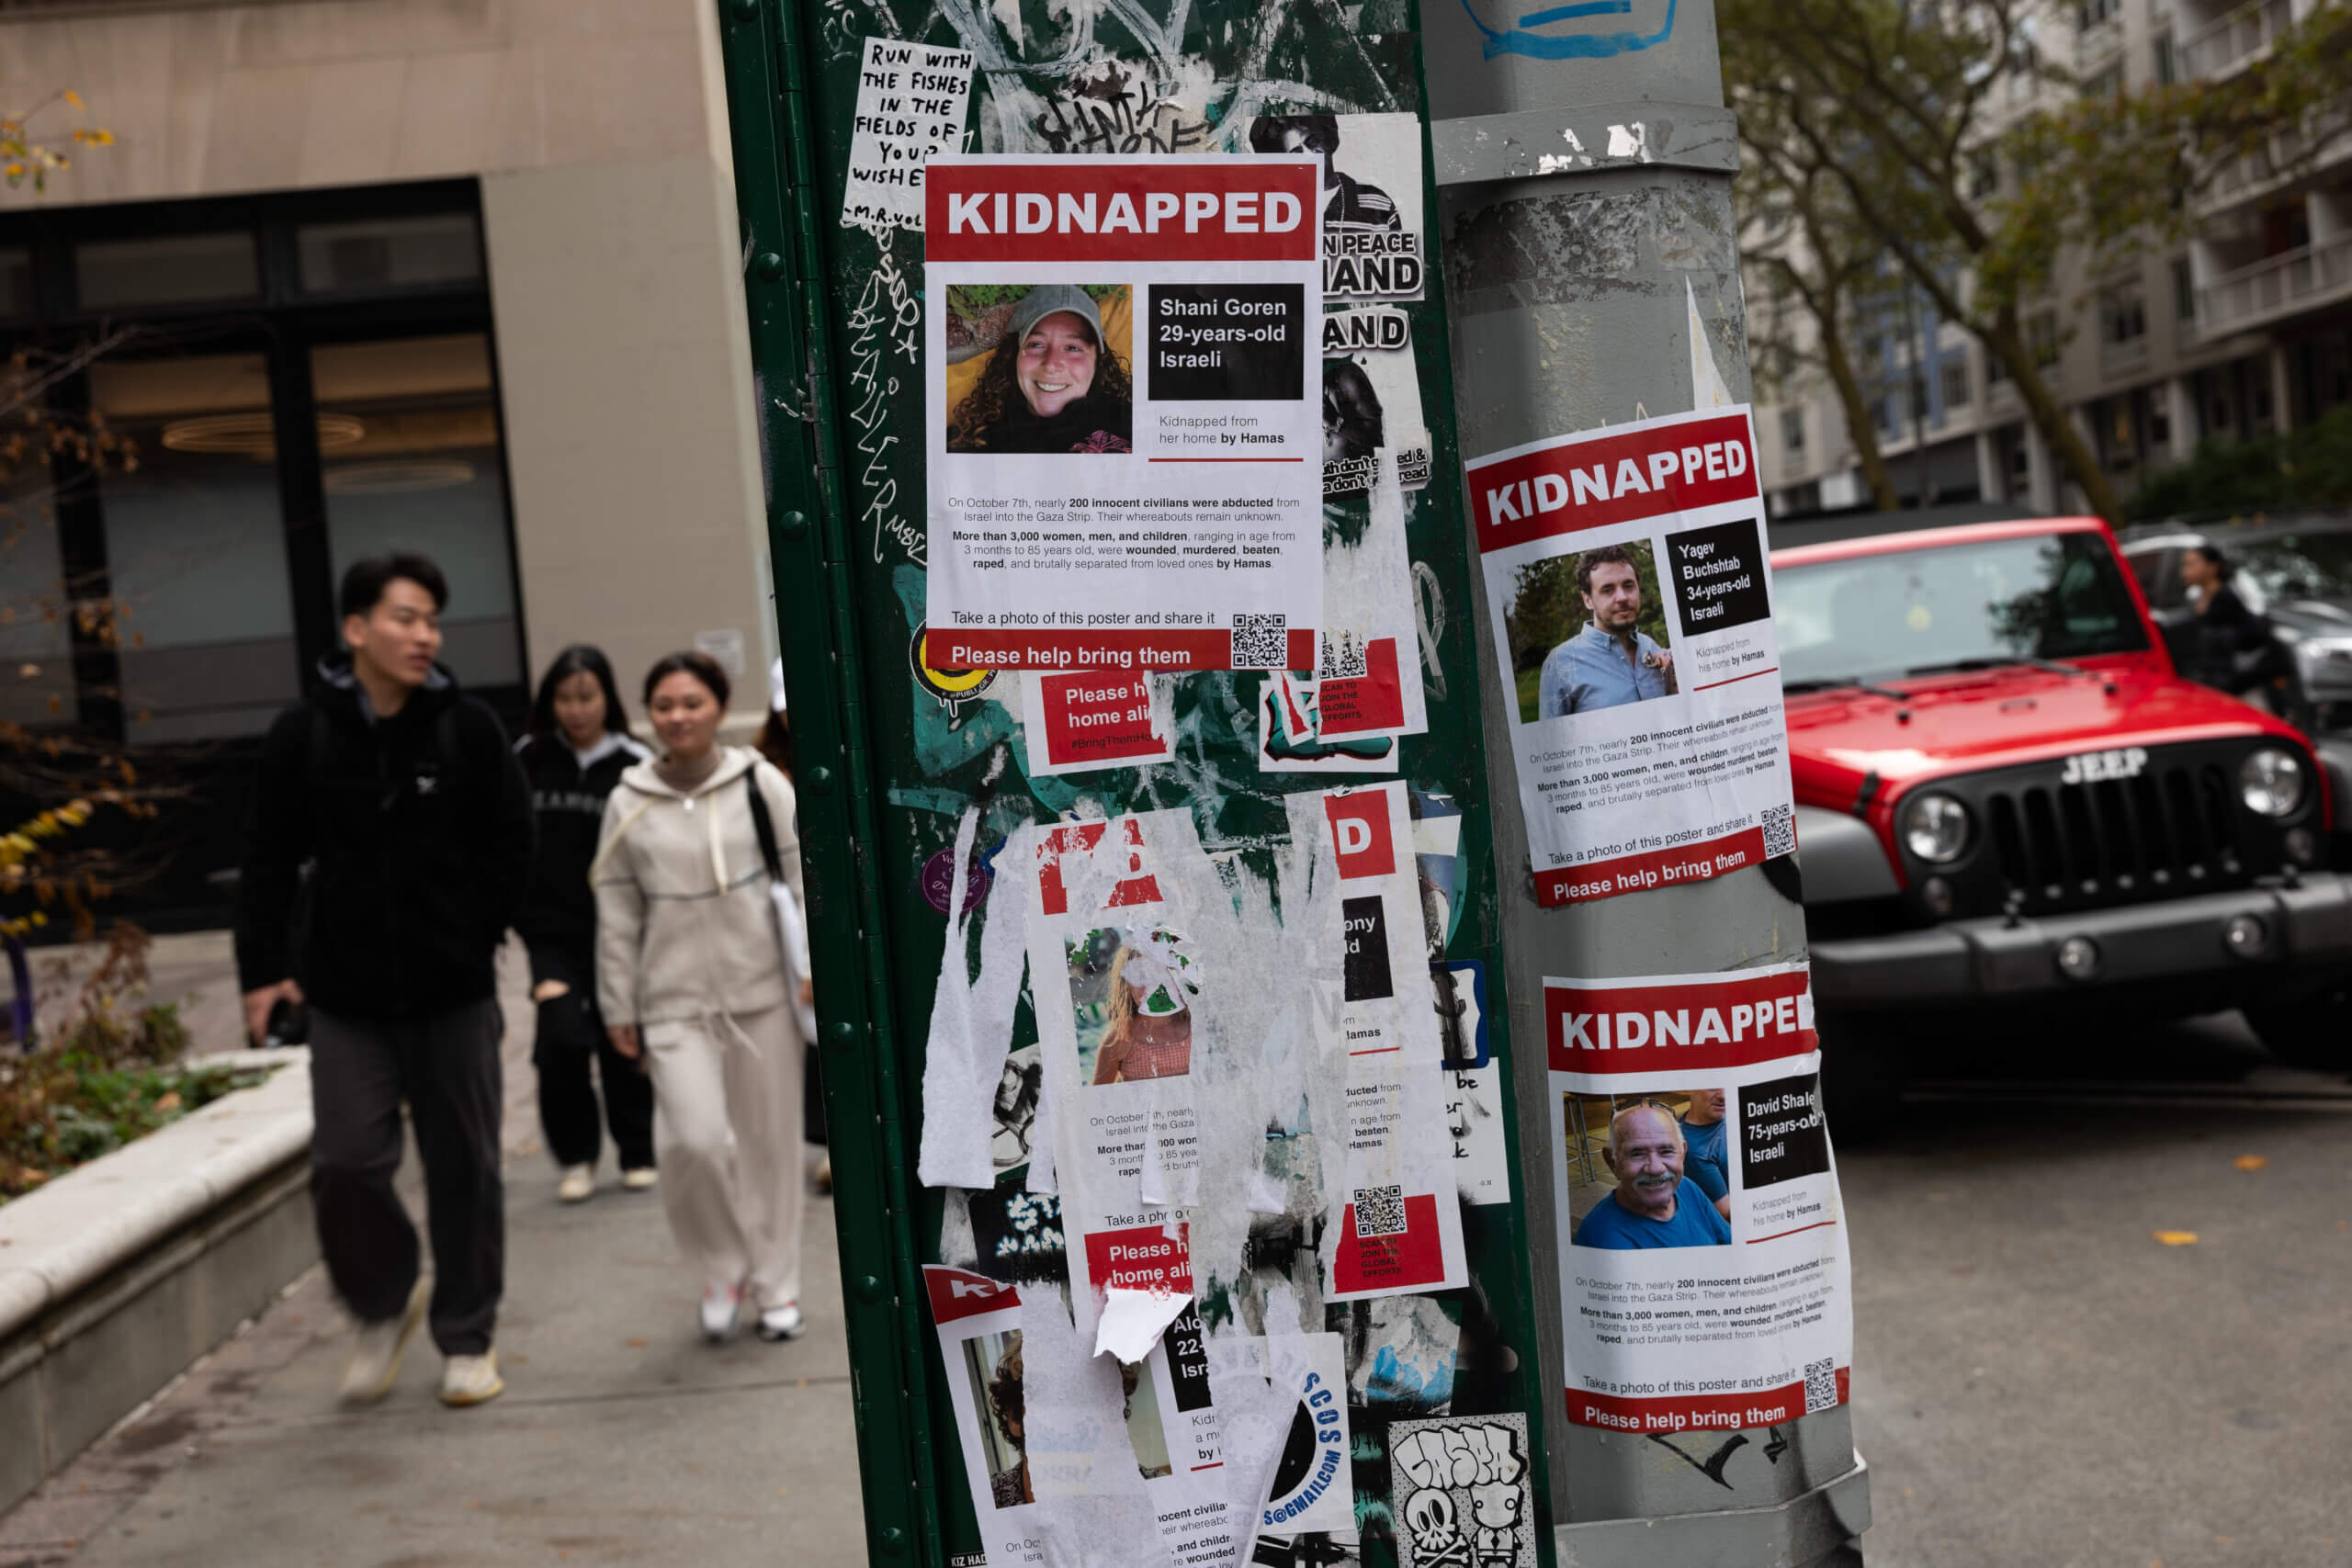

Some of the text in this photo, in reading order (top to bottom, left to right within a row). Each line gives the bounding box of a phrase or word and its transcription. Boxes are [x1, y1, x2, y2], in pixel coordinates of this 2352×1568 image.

[872, 45, 972, 69] RUN WITH
[863, 72, 967, 96] THE FISHES
[879, 97, 954, 116] IN THE
[855, 116, 957, 139] FIELDS OF
[853, 168, 925, 186] WISHE
[949, 192, 1302, 234] KIDNAPPED
[1342, 233, 1415, 254] PEACE
[1160, 299, 1286, 316] Shani Goren
[1160, 325, 1285, 346] 29-years-old
[1160, 350, 1221, 368] Israeli
[1159, 416, 1258, 429] Kidnapped from
[1159, 433, 1285, 446] her home by Hamas
[1340, 457, 1370, 475] don't
[1334, 475, 1366, 492] don't
[1486, 439, 1747, 526] KIDNAPPED
[948, 497, 1300, 509] On October 7th, nearly 200 innocent civilians were abducted from
[964, 512, 1283, 524] Israel into the Gaza Strip. Their whereabouts remain unknown.
[953, 531, 1296, 544] More than 3,000 women, men, and children, ranging in age from
[964, 545, 971, 555] 3
[974, 546, 1012, 555] months
[1014, 547, 1025, 555] to
[1027, 545, 1041, 555] 85
[1044, 547, 1072, 558] years
[1075, 546, 1094, 556] old,
[1098, 547, 1123, 555] were
[1679, 542, 1715, 559] Yagev
[973, 558, 1007, 570] raped,
[1011, 559, 1031, 569] and
[1034, 558, 1072, 570] brutally
[1075, 558, 1128, 570] separated
[1131, 558, 1154, 569] from
[1157, 558, 1185, 569] loved
[1188, 560, 1214, 569] ones
[1216, 558, 1230, 570] by
[1683, 556, 1741, 581] Buchshtab
[1687, 574, 1751, 601] 34-years-old
[952, 611, 1216, 627] Take a photo of this poster and share it
[1690, 601, 1724, 622] Israeli
[1695, 638, 1751, 658] Kidnapped from
[952, 646, 1191, 669] Please help bring them
[1698, 650, 1765, 673] his home by Hamas
[1066, 686, 1128, 705] Please
[1069, 711, 1121, 728] home
[2061, 747, 2148, 784] JEEP
[1548, 815, 1754, 864] Take a photo of this poster and share it
[1554, 851, 1747, 900] Please help bring them
[1380, 1083, 1402, 1092] from
[1747, 1091, 1815, 1118] David Shale
[1090, 1108, 1193, 1126] On October nearly
[1359, 1112, 1401, 1126] age from
[1105, 1119, 1194, 1136] Israel the Gaza
[1097, 1145, 1123, 1155] More
[1166, 1150, 1178, 1159] 85
[1749, 1141, 1784, 1164] Israeli
[1105, 1214, 1146, 1226] Take a
[1786, 1202, 1822, 1220] by Hamas
[1109, 1244, 1170, 1262] Please
[1361, 1258, 1396, 1268] GLOBAL
[1112, 1268, 1164, 1284] home
[1363, 1268, 1402, 1279] EFFORTS
[1585, 1405, 1786, 1431] Please help bring them
[1198, 1447, 1214, 1461] by
[1177, 1540, 1197, 1552] and
[1186, 1546, 1236, 1563] wounded
